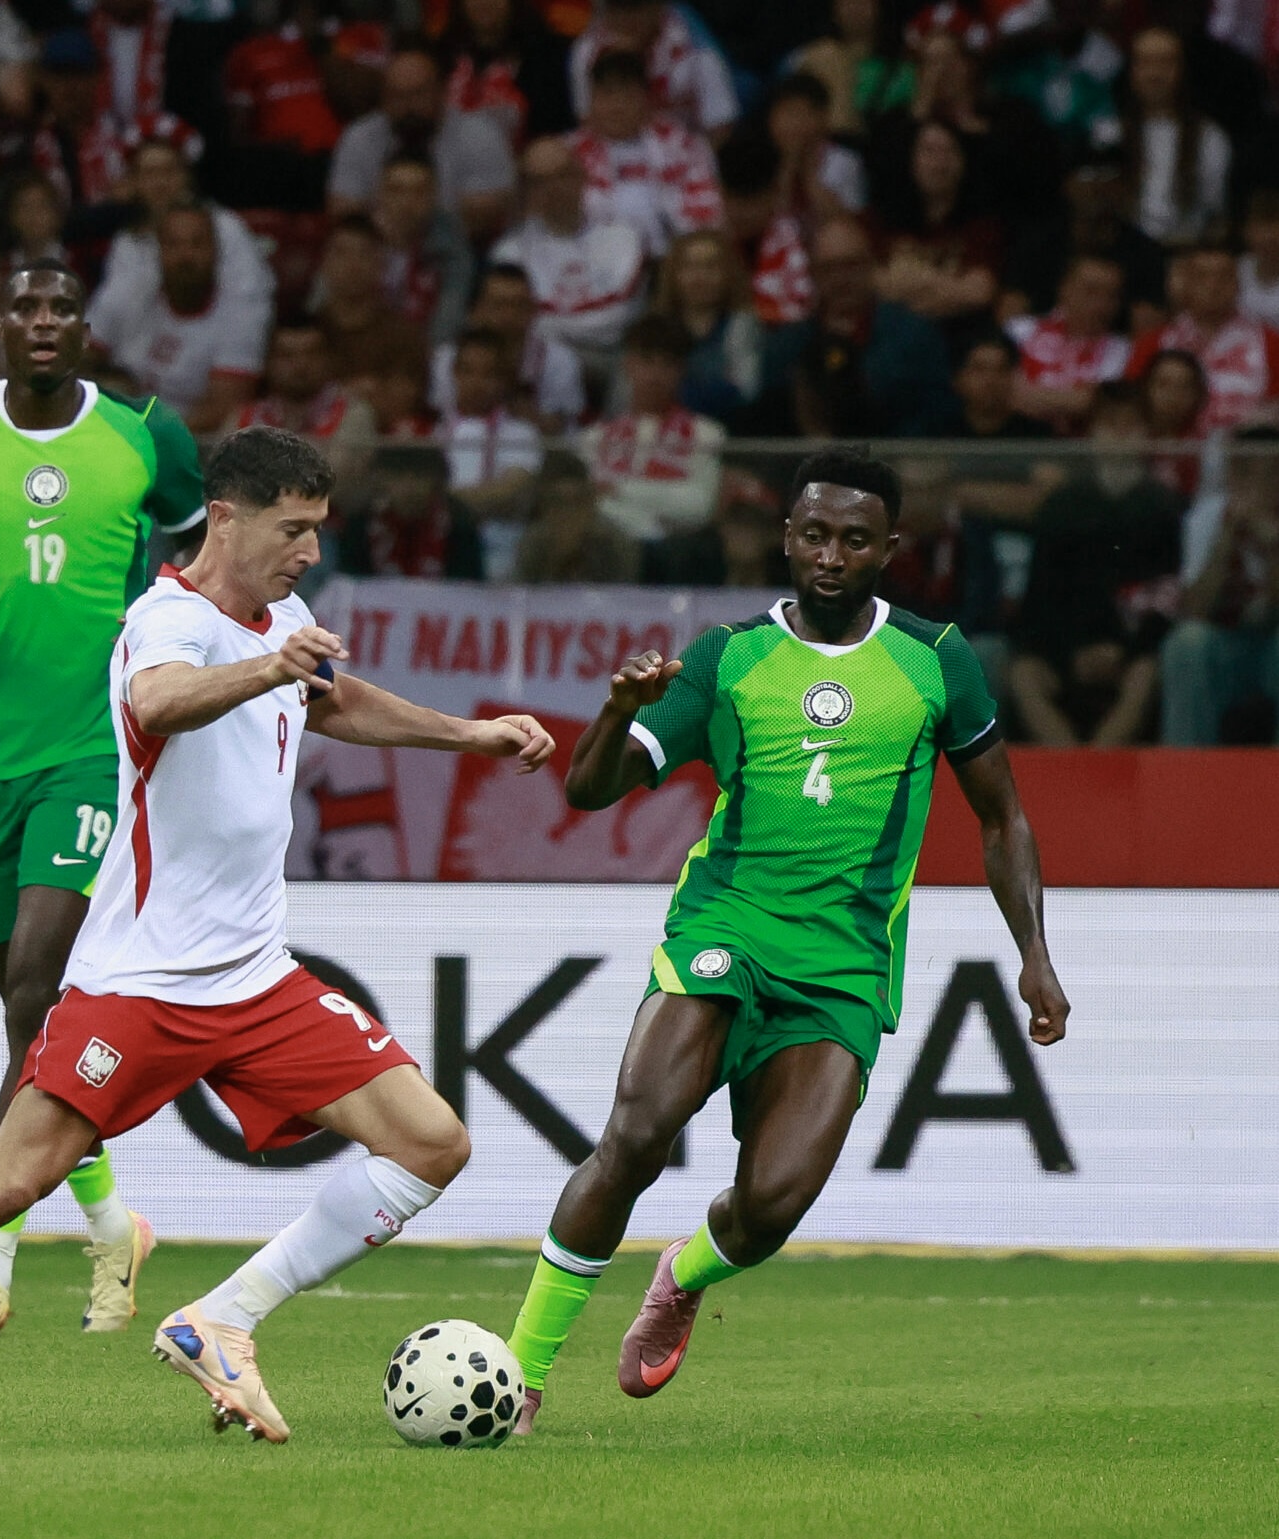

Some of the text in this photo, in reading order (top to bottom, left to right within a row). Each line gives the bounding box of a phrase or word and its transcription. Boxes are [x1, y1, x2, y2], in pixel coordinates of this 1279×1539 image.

[24, 533, 66, 584] 19
[277, 711, 288, 776] 9
[802, 751, 834, 807] 4
[75, 804, 113, 859] 19
[318, 992, 372, 1032] 9
